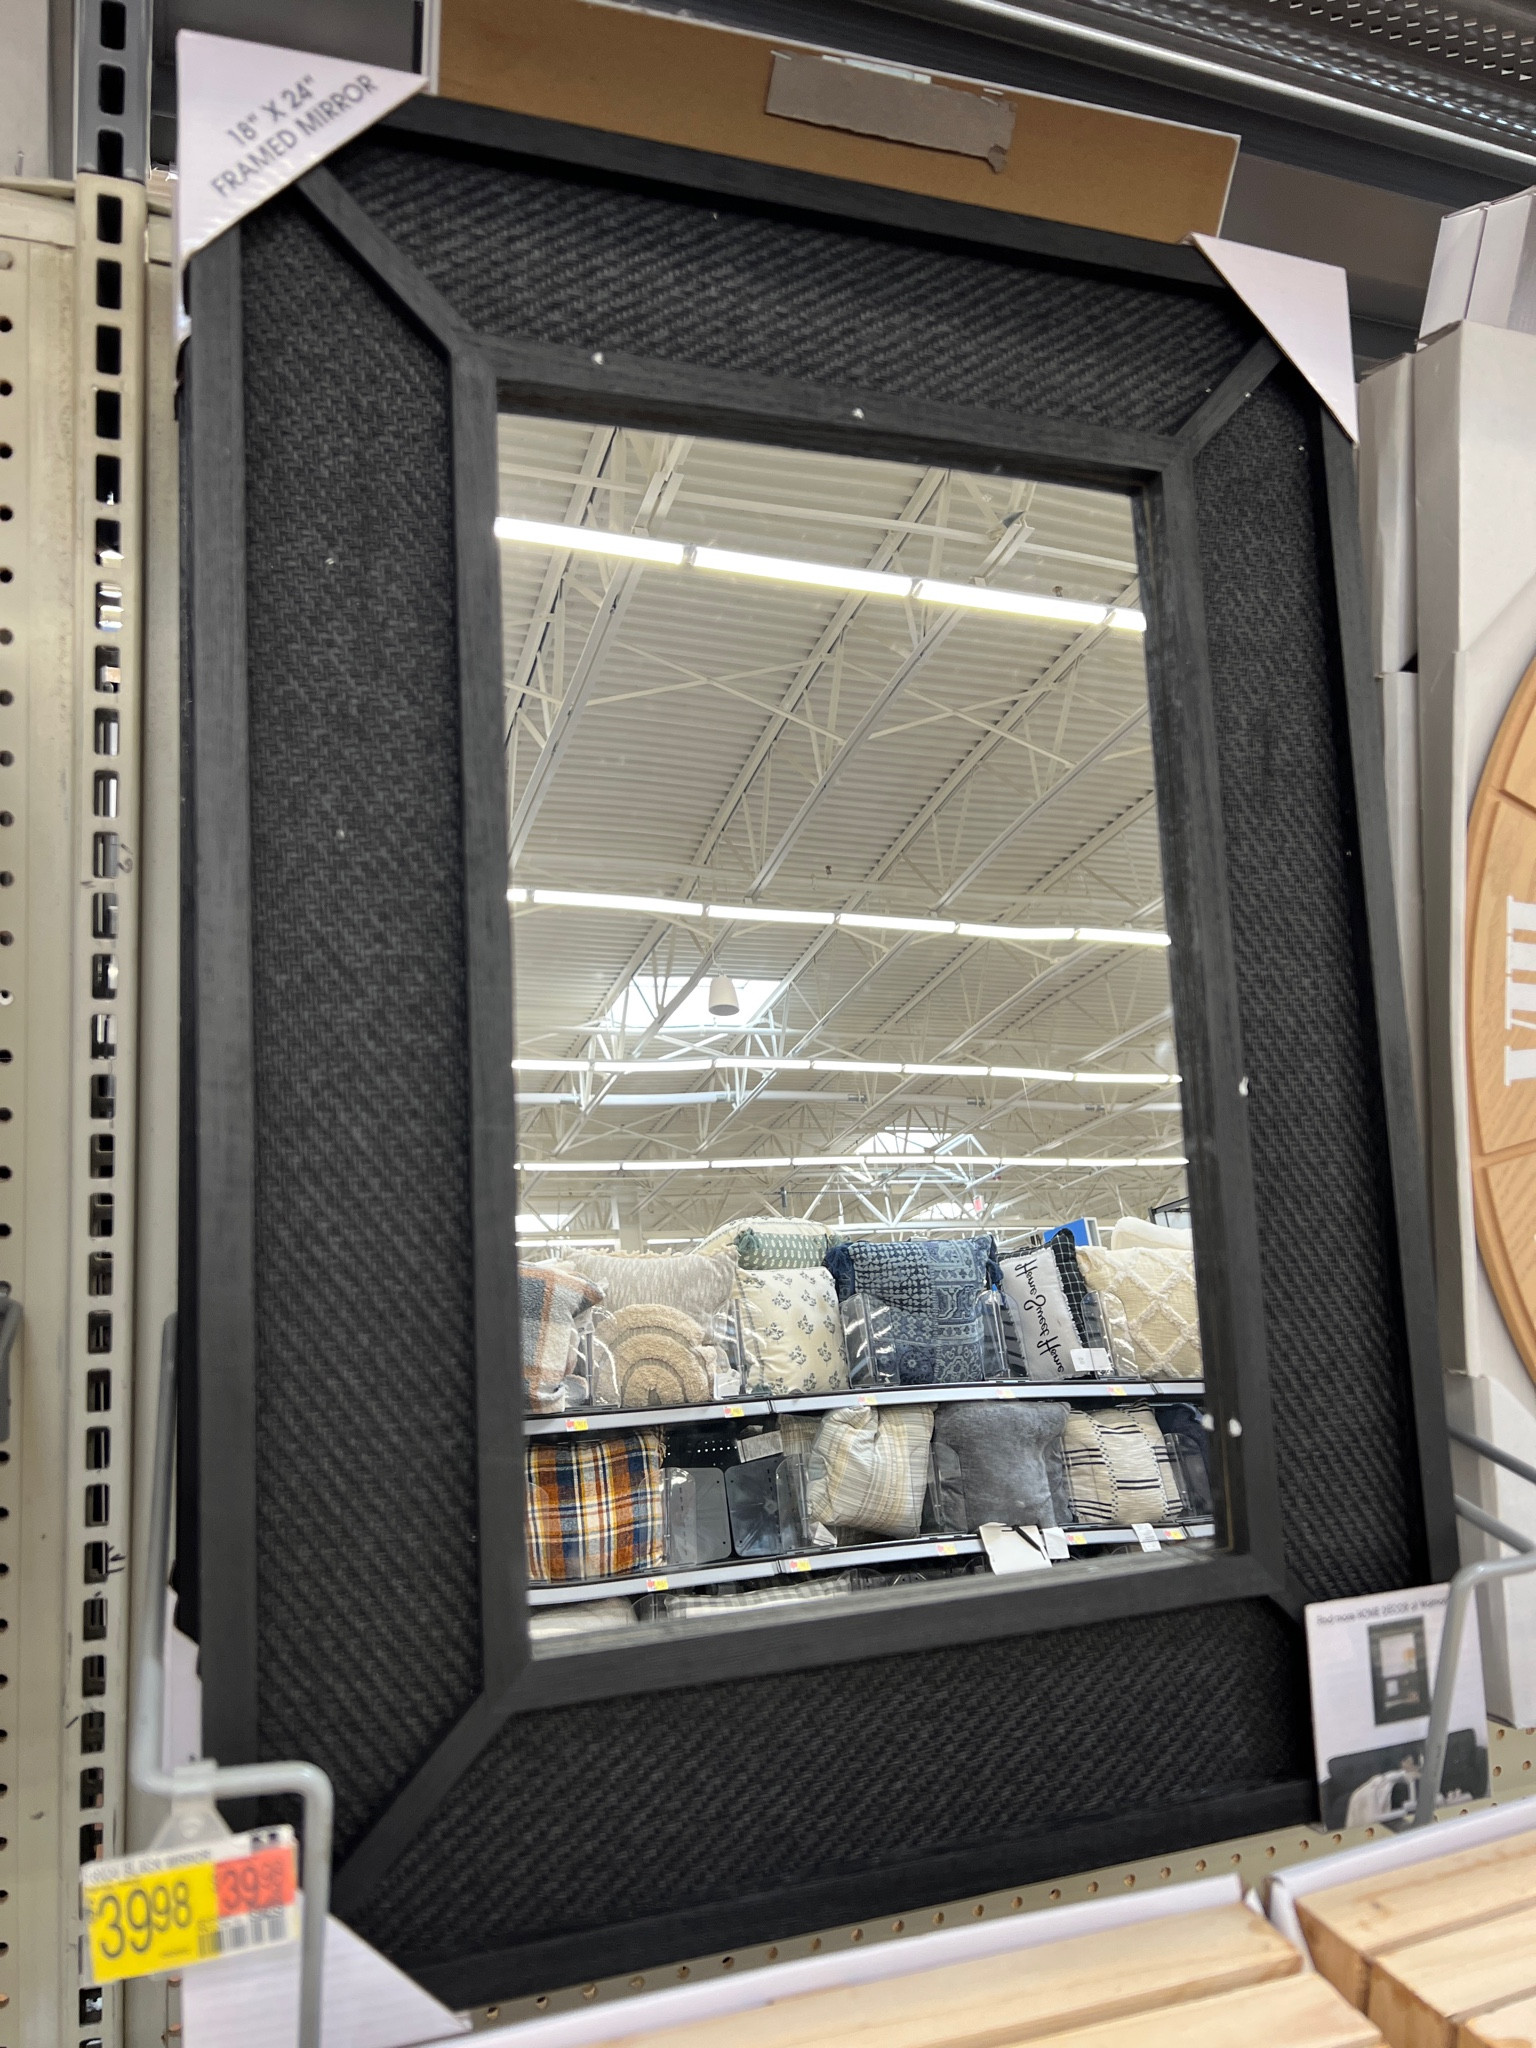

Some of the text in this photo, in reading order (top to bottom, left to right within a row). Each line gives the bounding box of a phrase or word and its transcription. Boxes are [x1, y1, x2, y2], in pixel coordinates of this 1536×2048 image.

[210, 73, 379, 198] FRAMED MIRROR
[226, 73, 316, 147] 18" X 24"
